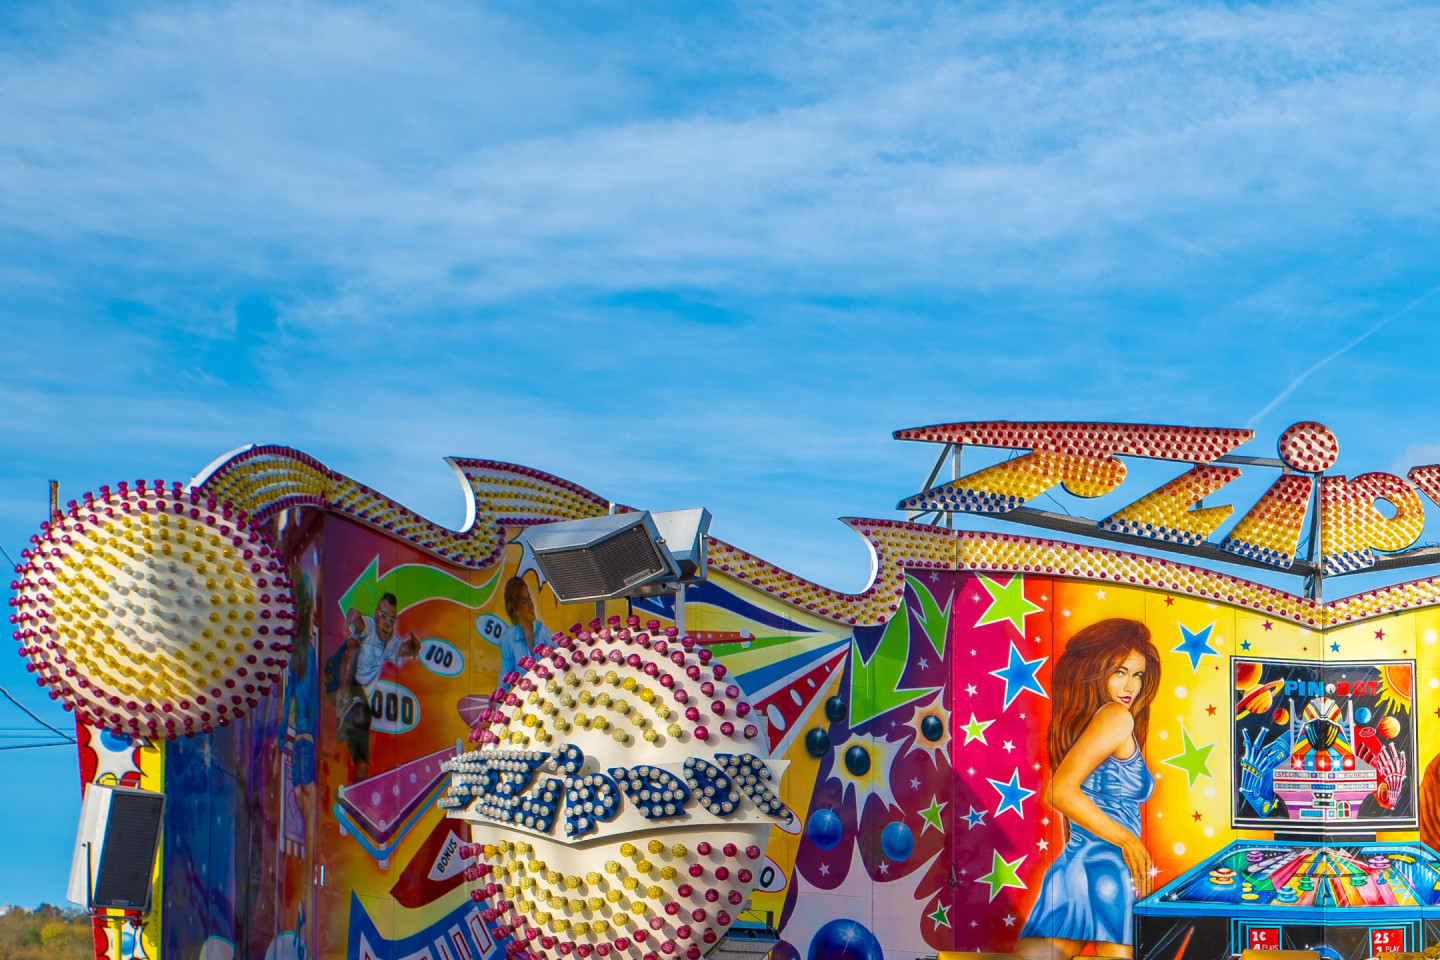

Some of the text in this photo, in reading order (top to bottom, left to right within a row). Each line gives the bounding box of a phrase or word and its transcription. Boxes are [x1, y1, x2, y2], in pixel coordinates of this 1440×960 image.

[485, 618, 502, 639] 50
[425, 645, 453, 669] 100
[1284, 680, 1379, 697] PIN BOT
[437, 839, 458, 873] BONUS
[1374, 932, 1389, 944] 25
